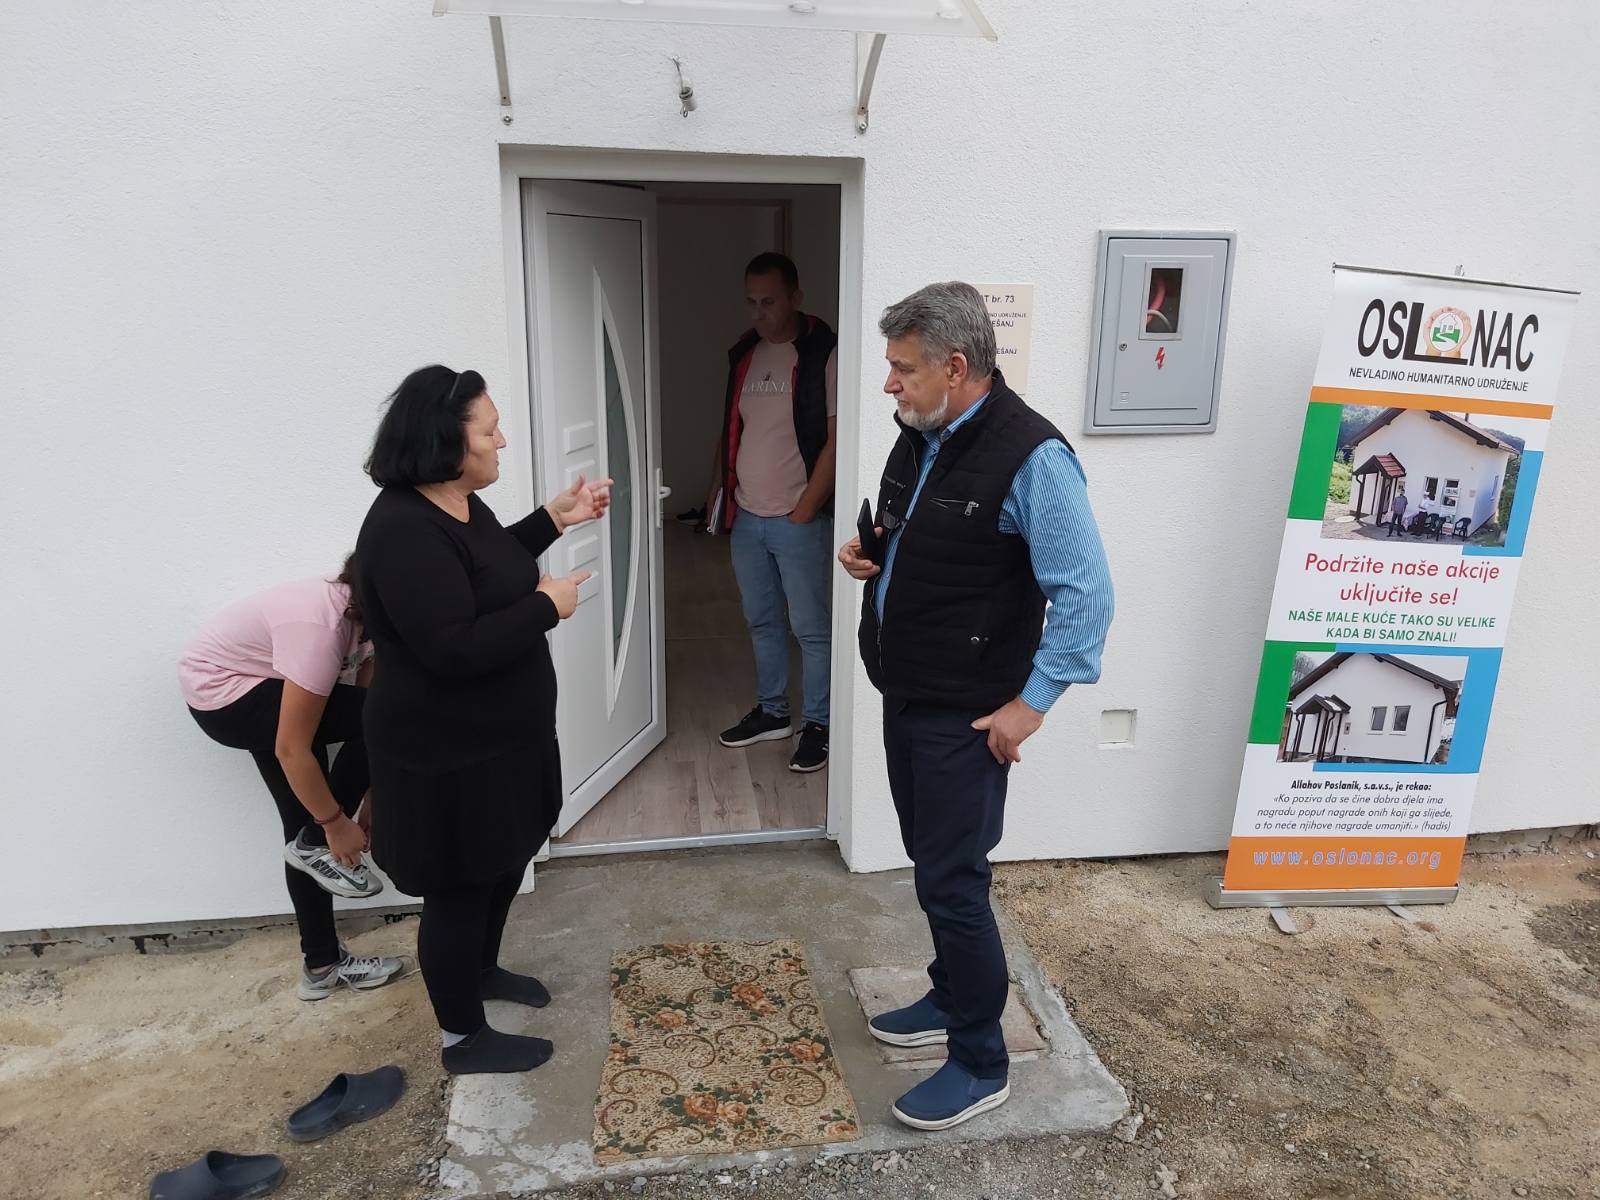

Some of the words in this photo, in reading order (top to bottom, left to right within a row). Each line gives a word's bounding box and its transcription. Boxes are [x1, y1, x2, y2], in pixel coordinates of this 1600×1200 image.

[991, 295, 1002, 303] br.
[1005, 295, 1015, 303] 73
[992, 320, 1014, 328] EŠANJ
[996, 347, 1017, 355] EŠANJ
[1349, 367, 1405, 381] NEVLADINO
[1406, 372, 1475, 387] HUMANITARNO
[1477, 377, 1529, 392] UDRUŽENJE
[1305, 553, 1384, 574] Podržite
[1391, 559, 1439, 577] naše
[1446, 560, 1500, 584] akcije
[1340, 582, 1423, 606] uključite
[1429, 587, 1458, 605] se!
[1288, 608, 1323, 622] NAŠE
[1326, 611, 1359, 623] MALE
[1362, 610, 1397, 625] KUĆE
[1400, 614, 1433, 626] TAKO
[1436, 615, 1454, 627] SU
[1457, 616, 1496, 628] VELIKE
[1326, 627, 1359, 639] KADA
[1363, 628, 1375, 639] BI
[1378, 629, 1415, 641] SAMO
[1417, 630, 1457, 643] ZNALI!
[1291, 780, 1322, 790] Allahov
[1324, 780, 1361, 792] Poslanik,
[1395, 781, 1404, 792] je
[1405, 781, 1432, 791] rekao:
[1291, 794, 1322, 805] poziva
[1325, 793, 1337, 803] da
[1352, 795, 1371, 804] čine
[1373, 794, 1400, 804] dobra
[1402, 794, 1425, 805] djela
[1426, 795, 1444, 804] ima
[1257, 807, 1296, 818] nagradu
[1297, 808, 1326, 818] poput
[1327, 807, 1366, 818] nagrade
[1368, 808, 1388, 817] onih
[1390, 808, 1408, 819] koji
[1409, 811, 1421, 819] ga
[1263, 821, 1273, 830] to
[1274, 821, 1297, 830] neće
[1299, 820, 1333, 831] njihove
[1335, 821, 1373, 832] nagrade
[1421, 821, 1451, 832] (hadis)
[1253, 847, 1441, 870] www.oslonac.org
